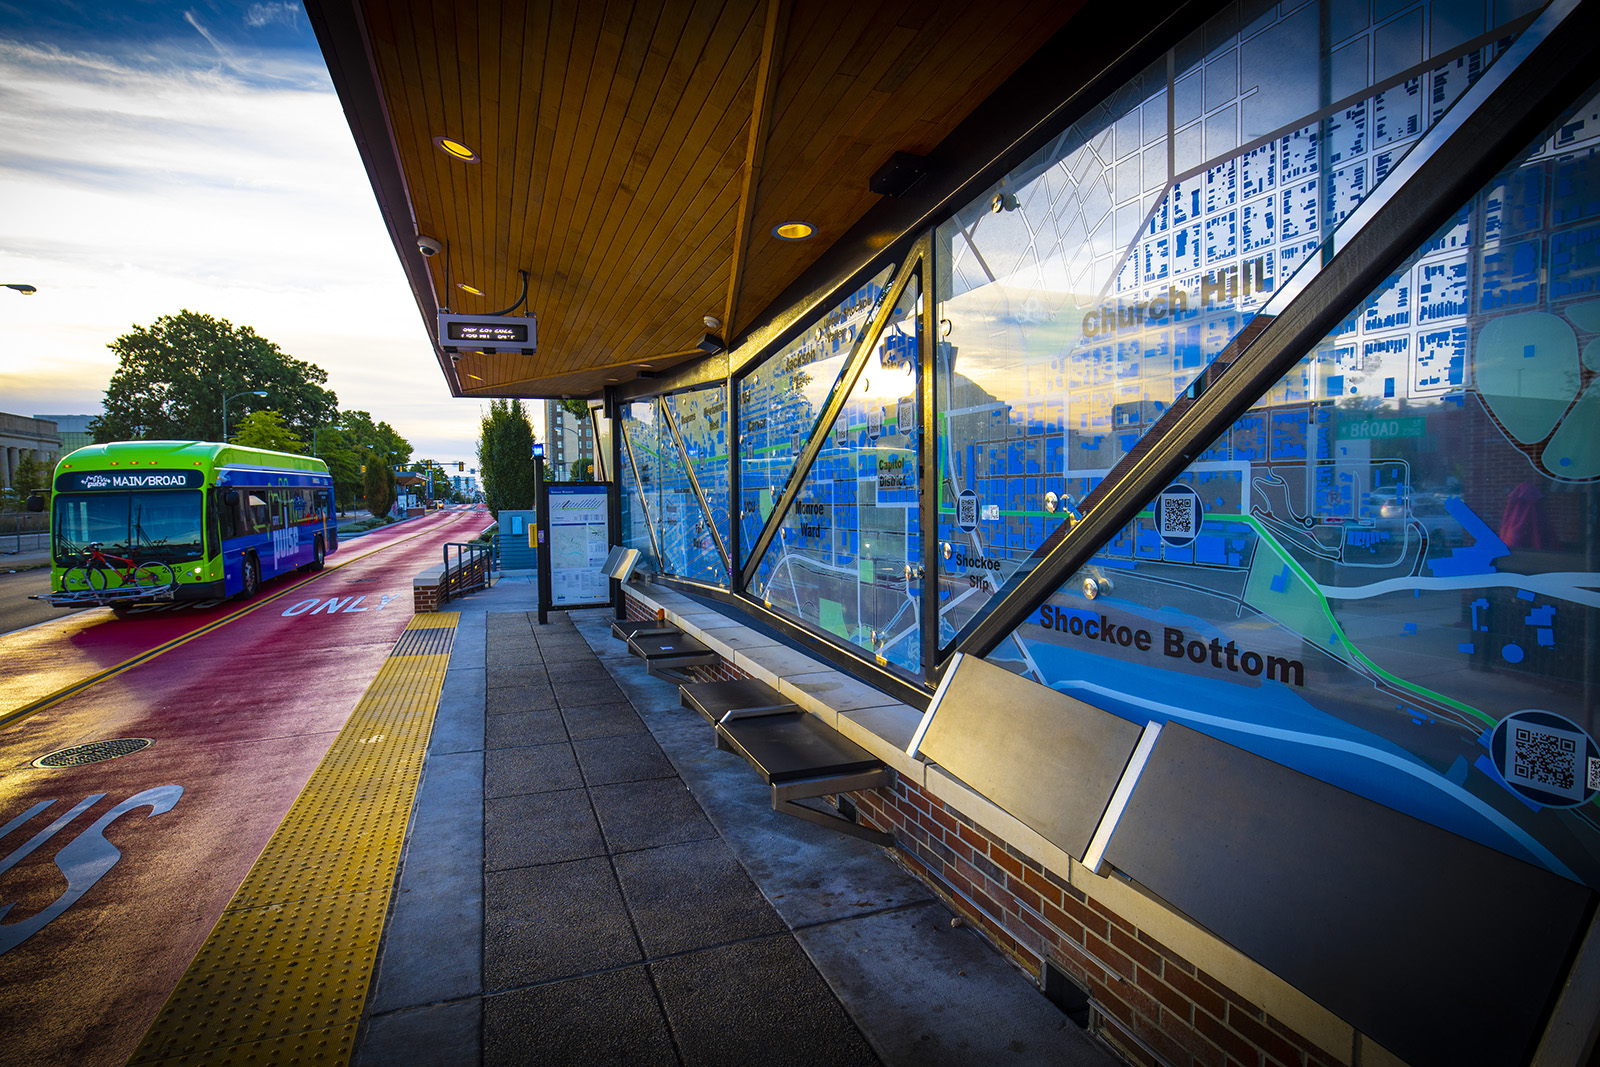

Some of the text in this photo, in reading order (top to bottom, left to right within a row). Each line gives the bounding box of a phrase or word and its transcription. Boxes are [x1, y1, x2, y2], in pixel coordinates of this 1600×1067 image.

[1082, 257, 1265, 338] Church Hill
[1350, 421, 1399, 437] BROAD
[879, 457, 905, 472] Capitol
[113, 475, 186, 486] MAIN/BROAD
[879, 474, 907, 487] District
[795, 500, 824, 515] Monroe
[272, 506, 299, 570] pulse
[800, 523, 821, 538] Ward
[956, 554, 1000, 571] Shockoe
[969, 575, 989, 593] Slip
[281, 593, 401, 617] ONLY
[1039, 603, 1305, 687] Shockoe Bottom
